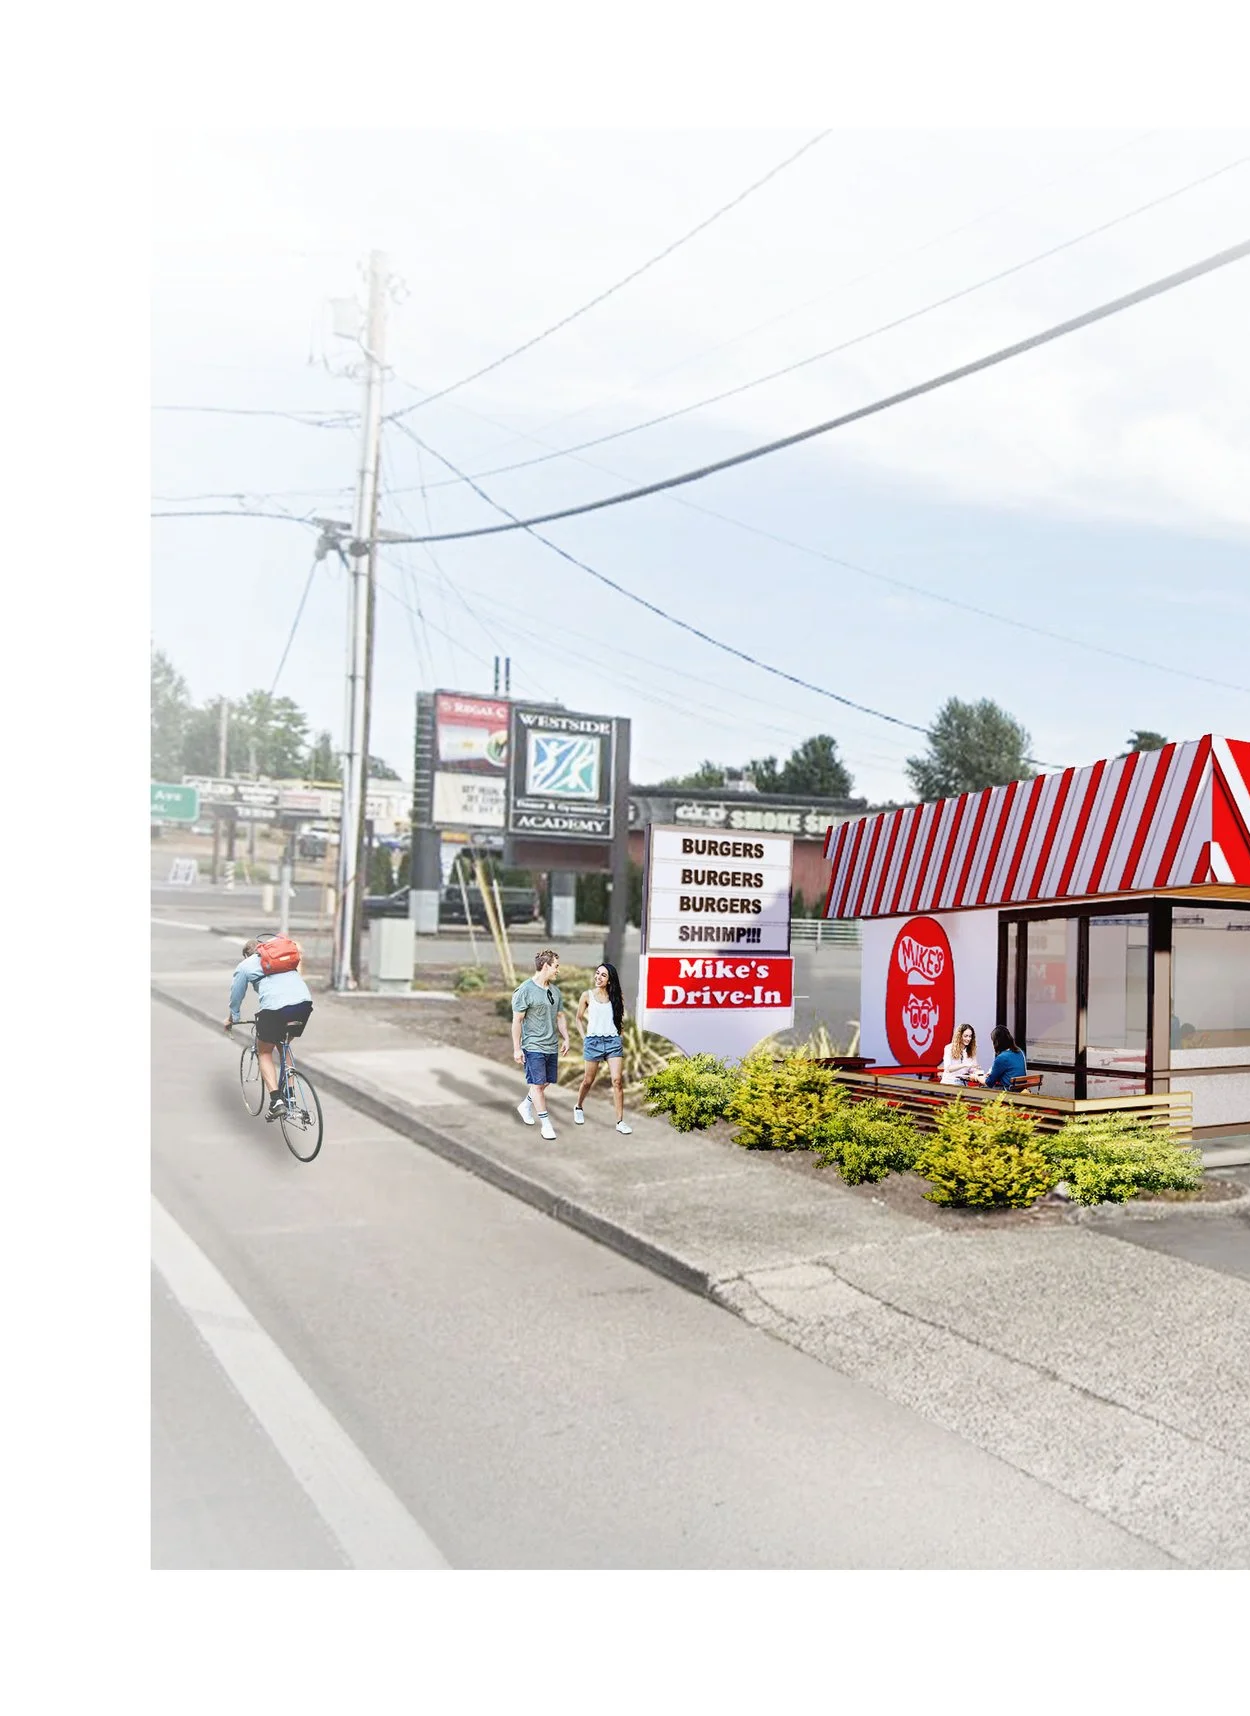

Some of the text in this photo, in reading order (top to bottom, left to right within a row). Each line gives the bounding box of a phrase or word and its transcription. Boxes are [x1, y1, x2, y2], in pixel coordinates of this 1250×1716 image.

[518, 713, 611, 735] WESTSIDE
[517, 815, 606, 833] ACADEMY
[730, 810, 801, 833] SMOKE
[682, 838, 764, 859] BURGERS
[681, 868, 764, 889] BURGERS
[679, 895, 762, 915] BURGERS
[678, 925, 762, 944] SHRIMP!!!
[901, 938, 944, 976] MIKE'S
[678, 958, 770, 980] Mike's
[661, 985, 783, 1006] Drive-In
